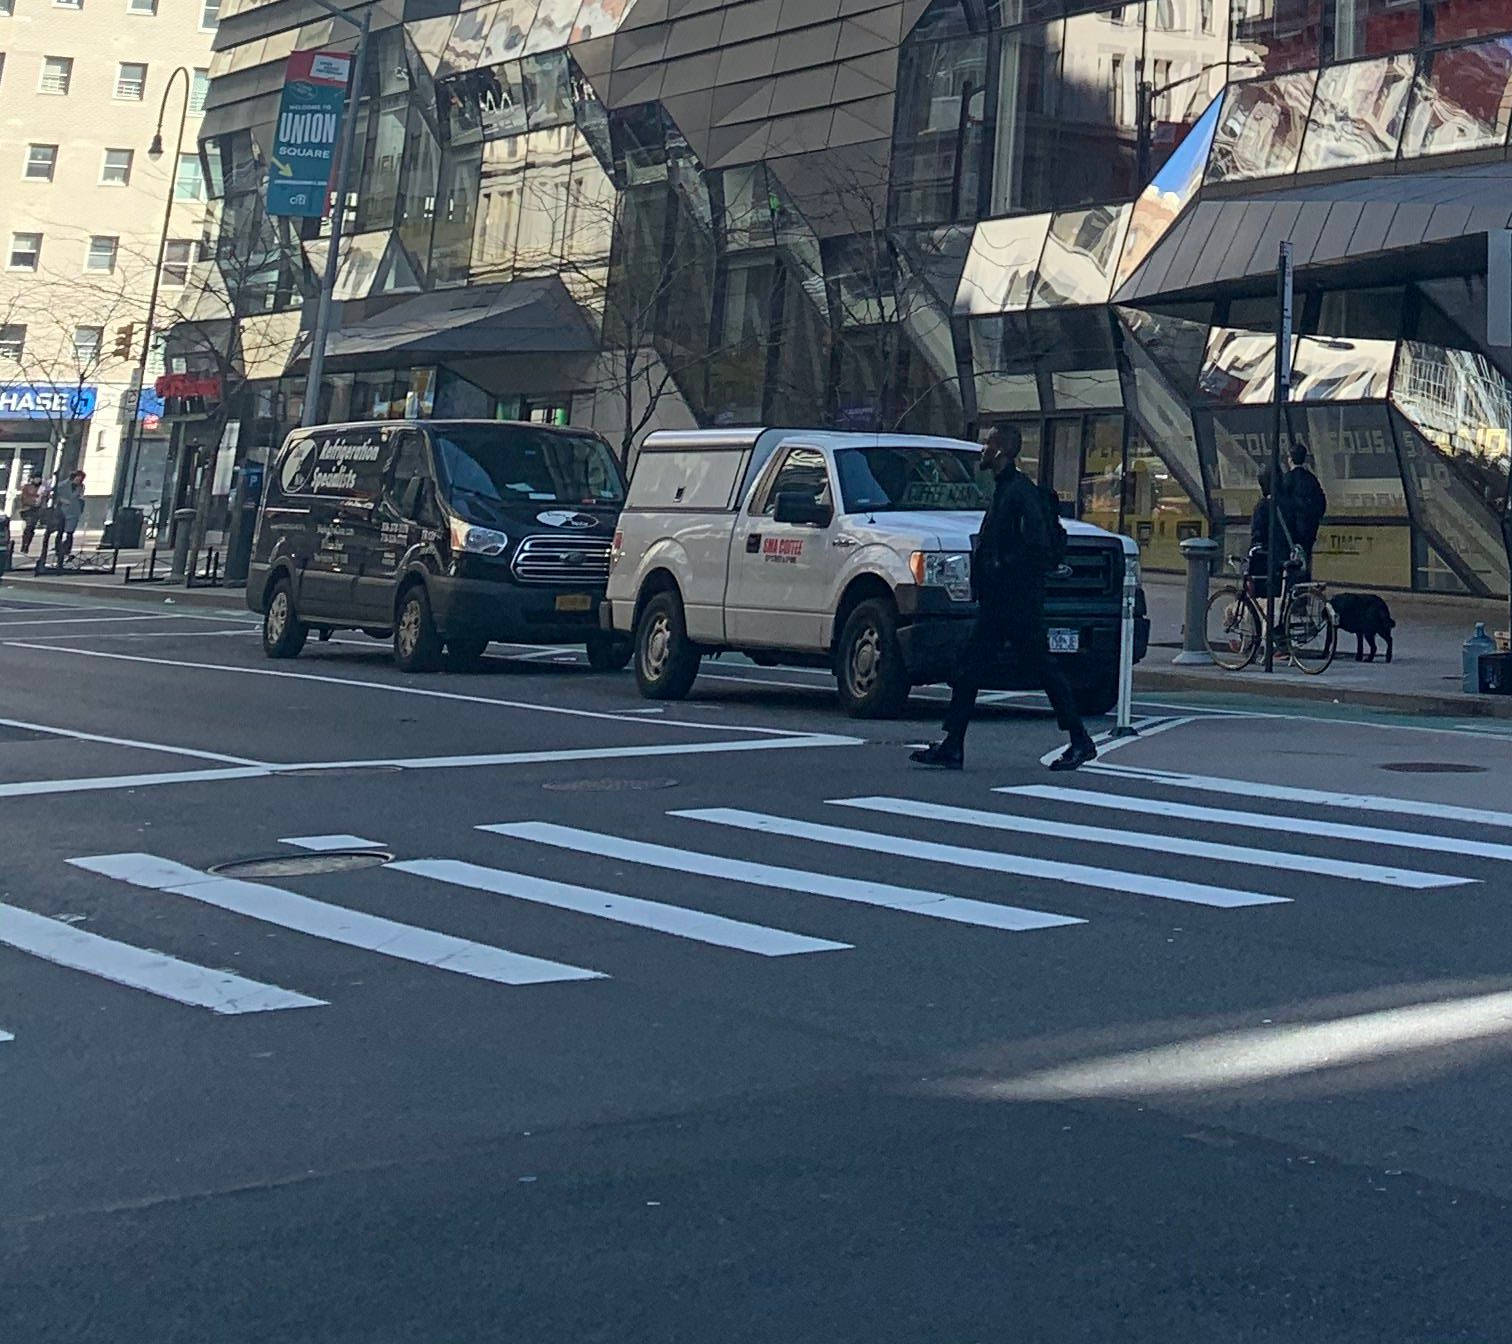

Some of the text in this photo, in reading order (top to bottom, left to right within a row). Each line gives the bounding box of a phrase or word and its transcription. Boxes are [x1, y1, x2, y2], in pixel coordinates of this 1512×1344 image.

[279, 113, 337, 145] UNION
[279, 146, 331, 159] SQUARE
[0, 392, 69, 411] HASE
[318, 438, 380, 464] Refrigeration
[310, 465, 358, 494] Specialists
